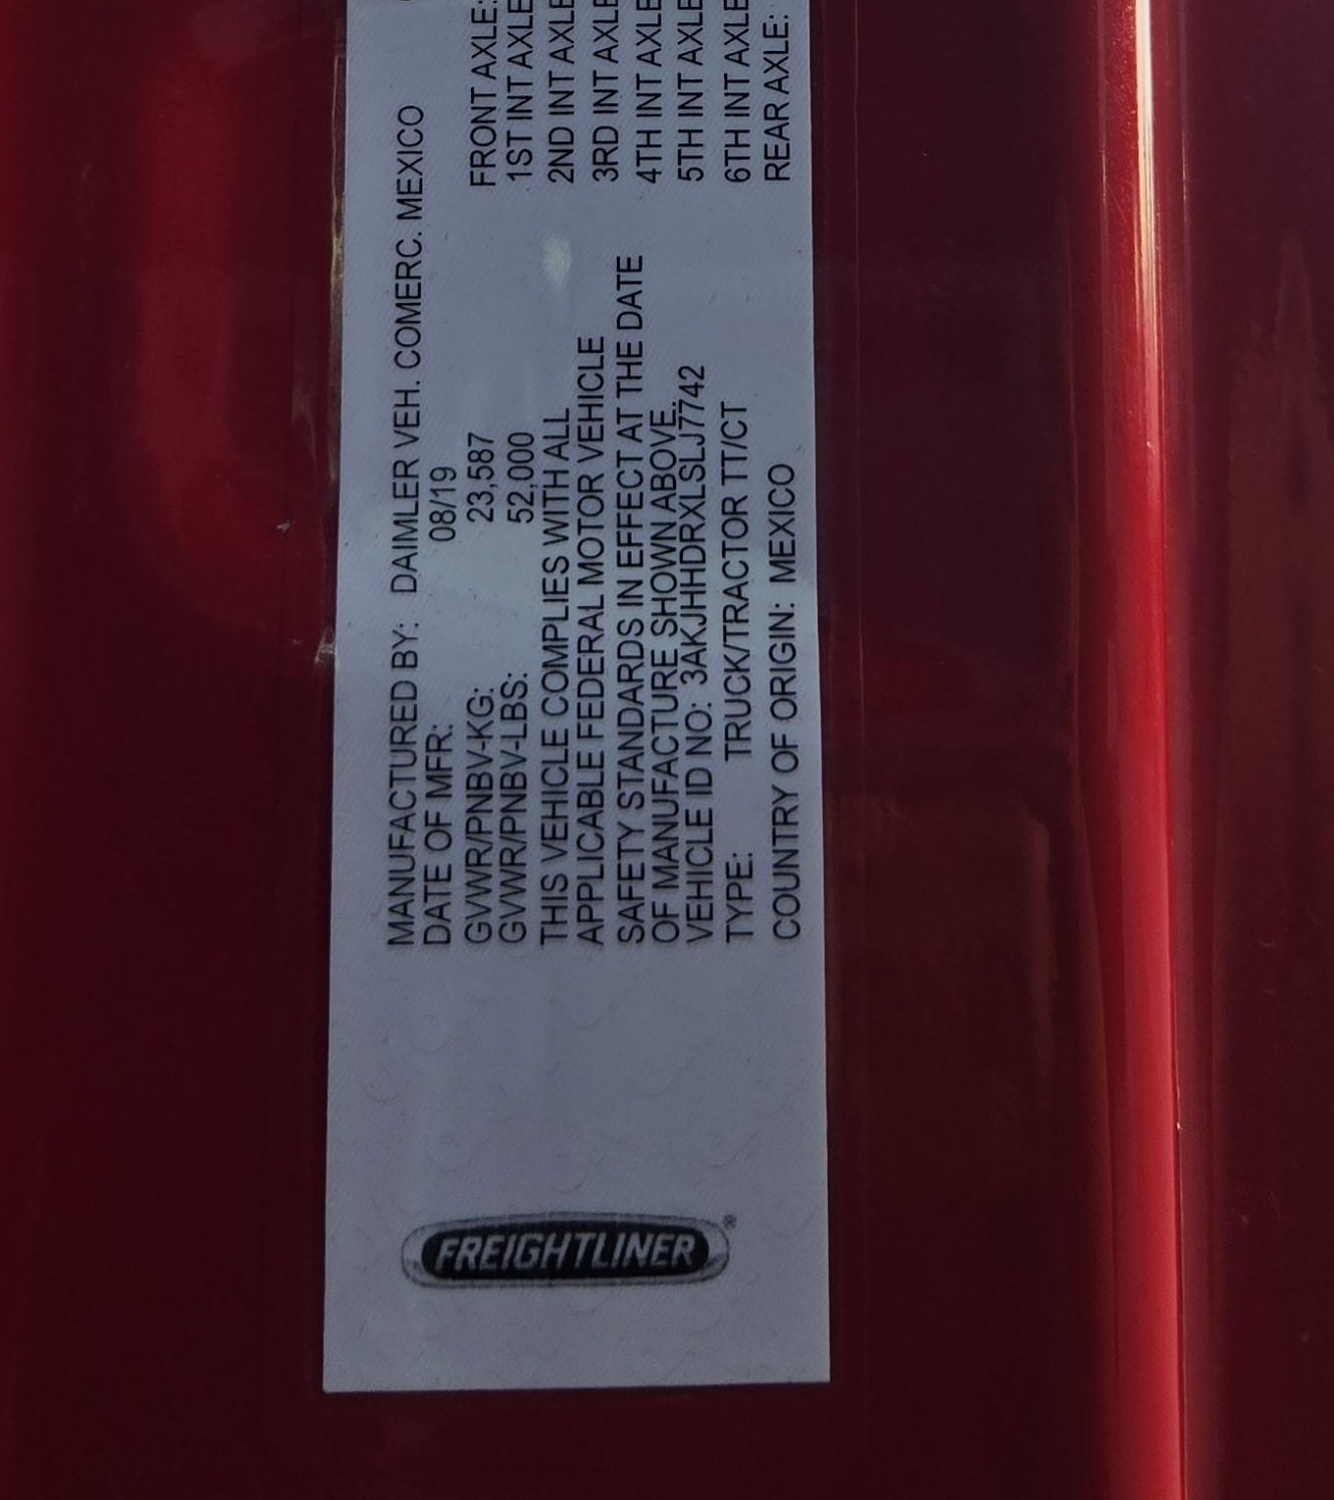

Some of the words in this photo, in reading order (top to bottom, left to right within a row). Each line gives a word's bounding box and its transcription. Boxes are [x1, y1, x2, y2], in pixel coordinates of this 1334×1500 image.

[471, 0, 498, 80] AXLE:
[762, 15, 789, 95] AXLE:
[506, 75, 533, 120] INT
[548, 70, 575, 115] INT
[592, 70, 619, 114] INT
[636, 73, 662, 118] INT
[677, 72, 703, 117] INT
[724, 73, 750, 117] INT
[396, 105, 424, 220] MEXICO
[470, 87, 497, 186] FRONT
[506, 130, 533, 181] 1ST
[547, 127, 574, 184] 2ND
[592, 126, 619, 182] 3RD
[636, 130, 662, 184] 4TH
[677, 129, 704, 182] 5TH
[724, 129, 751, 183] 6TH
[763, 102, 790, 181] REAR
[393, 232, 422, 370] COMERC.
[616, 255, 643, 330] DATE
[577, 336, 604, 463] VEHICLE
[616, 341, 643, 399] THE
[393, 381, 420, 449] VEH.
[542, 408, 570, 461] ALL
[616, 407, 643, 443] AT
[720, 401, 748, 486] TT/CT
[466, 432, 498, 523] 23,587
[506, 432, 538, 523] 52,000
[649, 402, 677, 513] ABOVE.
[390, 458, 420, 593] DAIMLER
[429, 467, 457, 542] 08/19
[542, 470, 569, 546] WITH
[577, 473, 604, 585] MOTOR
[616, 450, 644, 568] EFFECT
[678, 366, 708, 685] 3AKJHHDRXLSLJ7742
[767, 464, 796, 583] MEXICO
[616, 580, 644, 607] IN
[650, 522, 678, 637] SHOWN
[391, 623, 419, 671] BY:
[541, 556, 569, 717] COMPLIES
[577, 594, 604, 740] FEDERAL
[721, 495, 752, 762] TRUCK/TRACTOR
[768, 603, 798, 723] ORIGIN:
[617, 618, 645, 810] STANDARDS
[685, 702, 712, 756] NO:
[771, 733, 799, 775] OF
[425, 725, 453, 800] MFR:
[541, 728, 569, 863] VEHICLE
[651, 649, 679, 890] MANUFACTURE
[685, 767, 713, 797] ID
[387, 680, 417, 948] MANUFACTURED
[424, 810, 452, 853] OF
[464, 688, 494, 945] GVWR/PNBV-KG:
[498, 673, 528, 945] GVWR/PNBV-LBS:
[576, 750, 605, 948] APPLICABLE
[617, 821, 645, 946] SAFETY
[685, 808, 713, 945] VEHICLE
[725, 853, 754, 944] TYPE:
[771, 784, 801, 941] COUNTRY
[423, 864, 452, 948] DATE
[539, 873, 568, 948] THIS
[651, 901, 680, 945] OF
[434, 1231, 696, 1271] FREIGHTLINER
